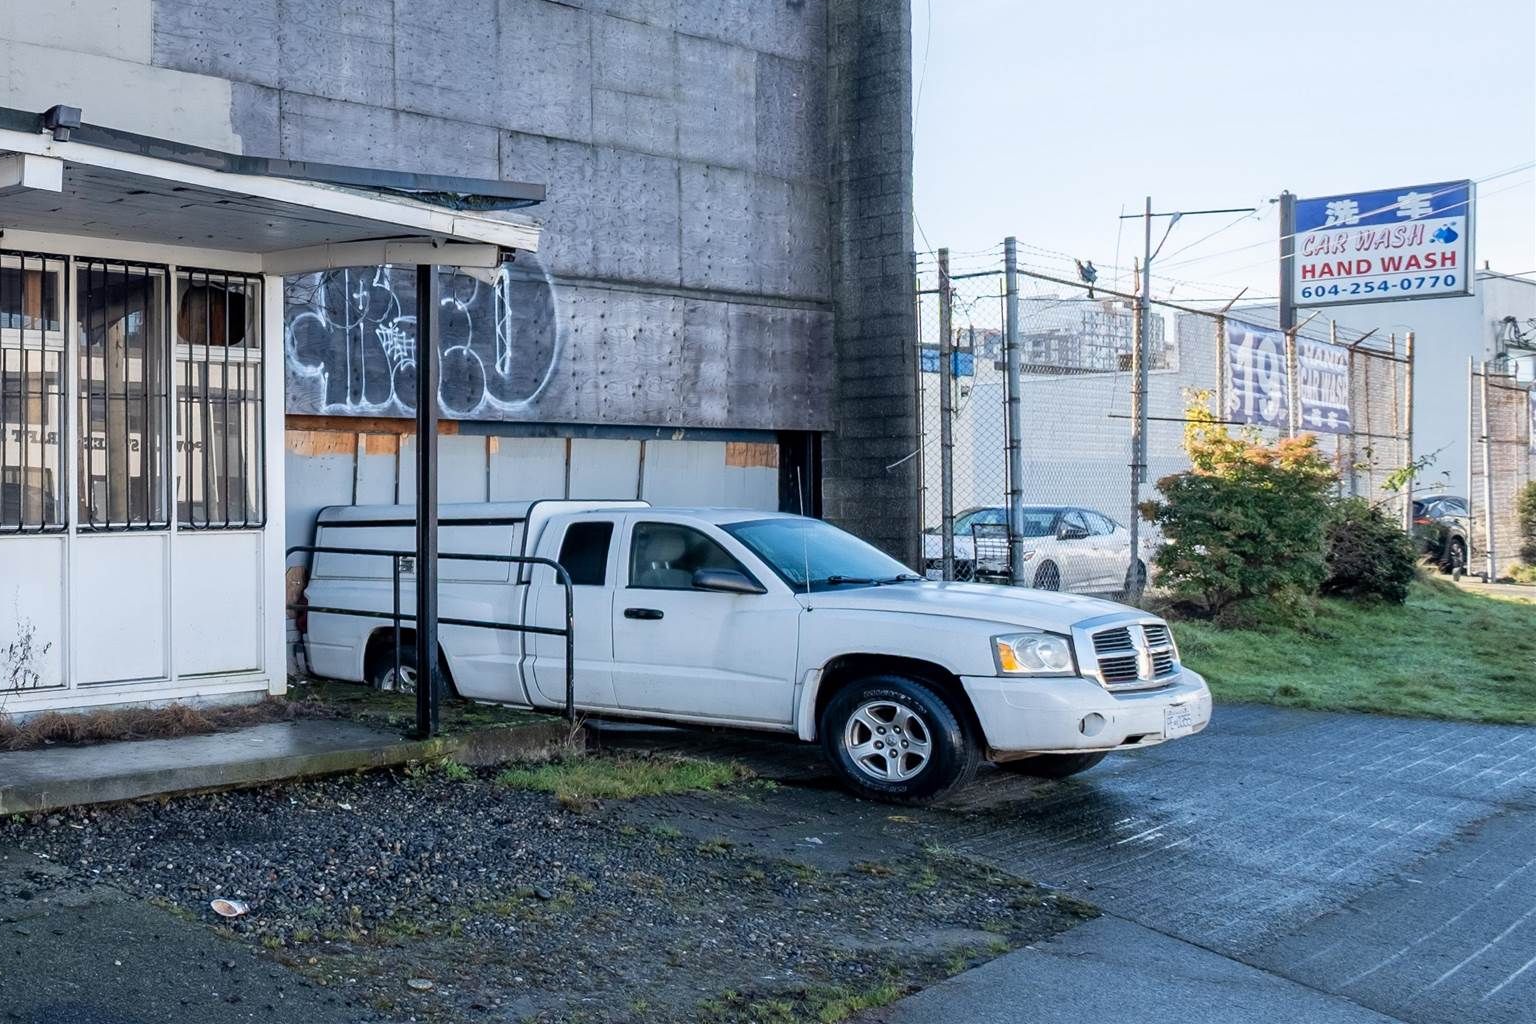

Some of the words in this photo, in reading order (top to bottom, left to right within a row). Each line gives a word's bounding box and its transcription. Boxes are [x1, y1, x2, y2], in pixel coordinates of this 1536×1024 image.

[1302, 231, 1349, 257] CAR
[1355, 223, 1425, 252] WASH
[1301, 259, 1373, 280] HAND
[1381, 250, 1457, 273] WASH
[1301, 274, 1457, 299] 604-254-0770
